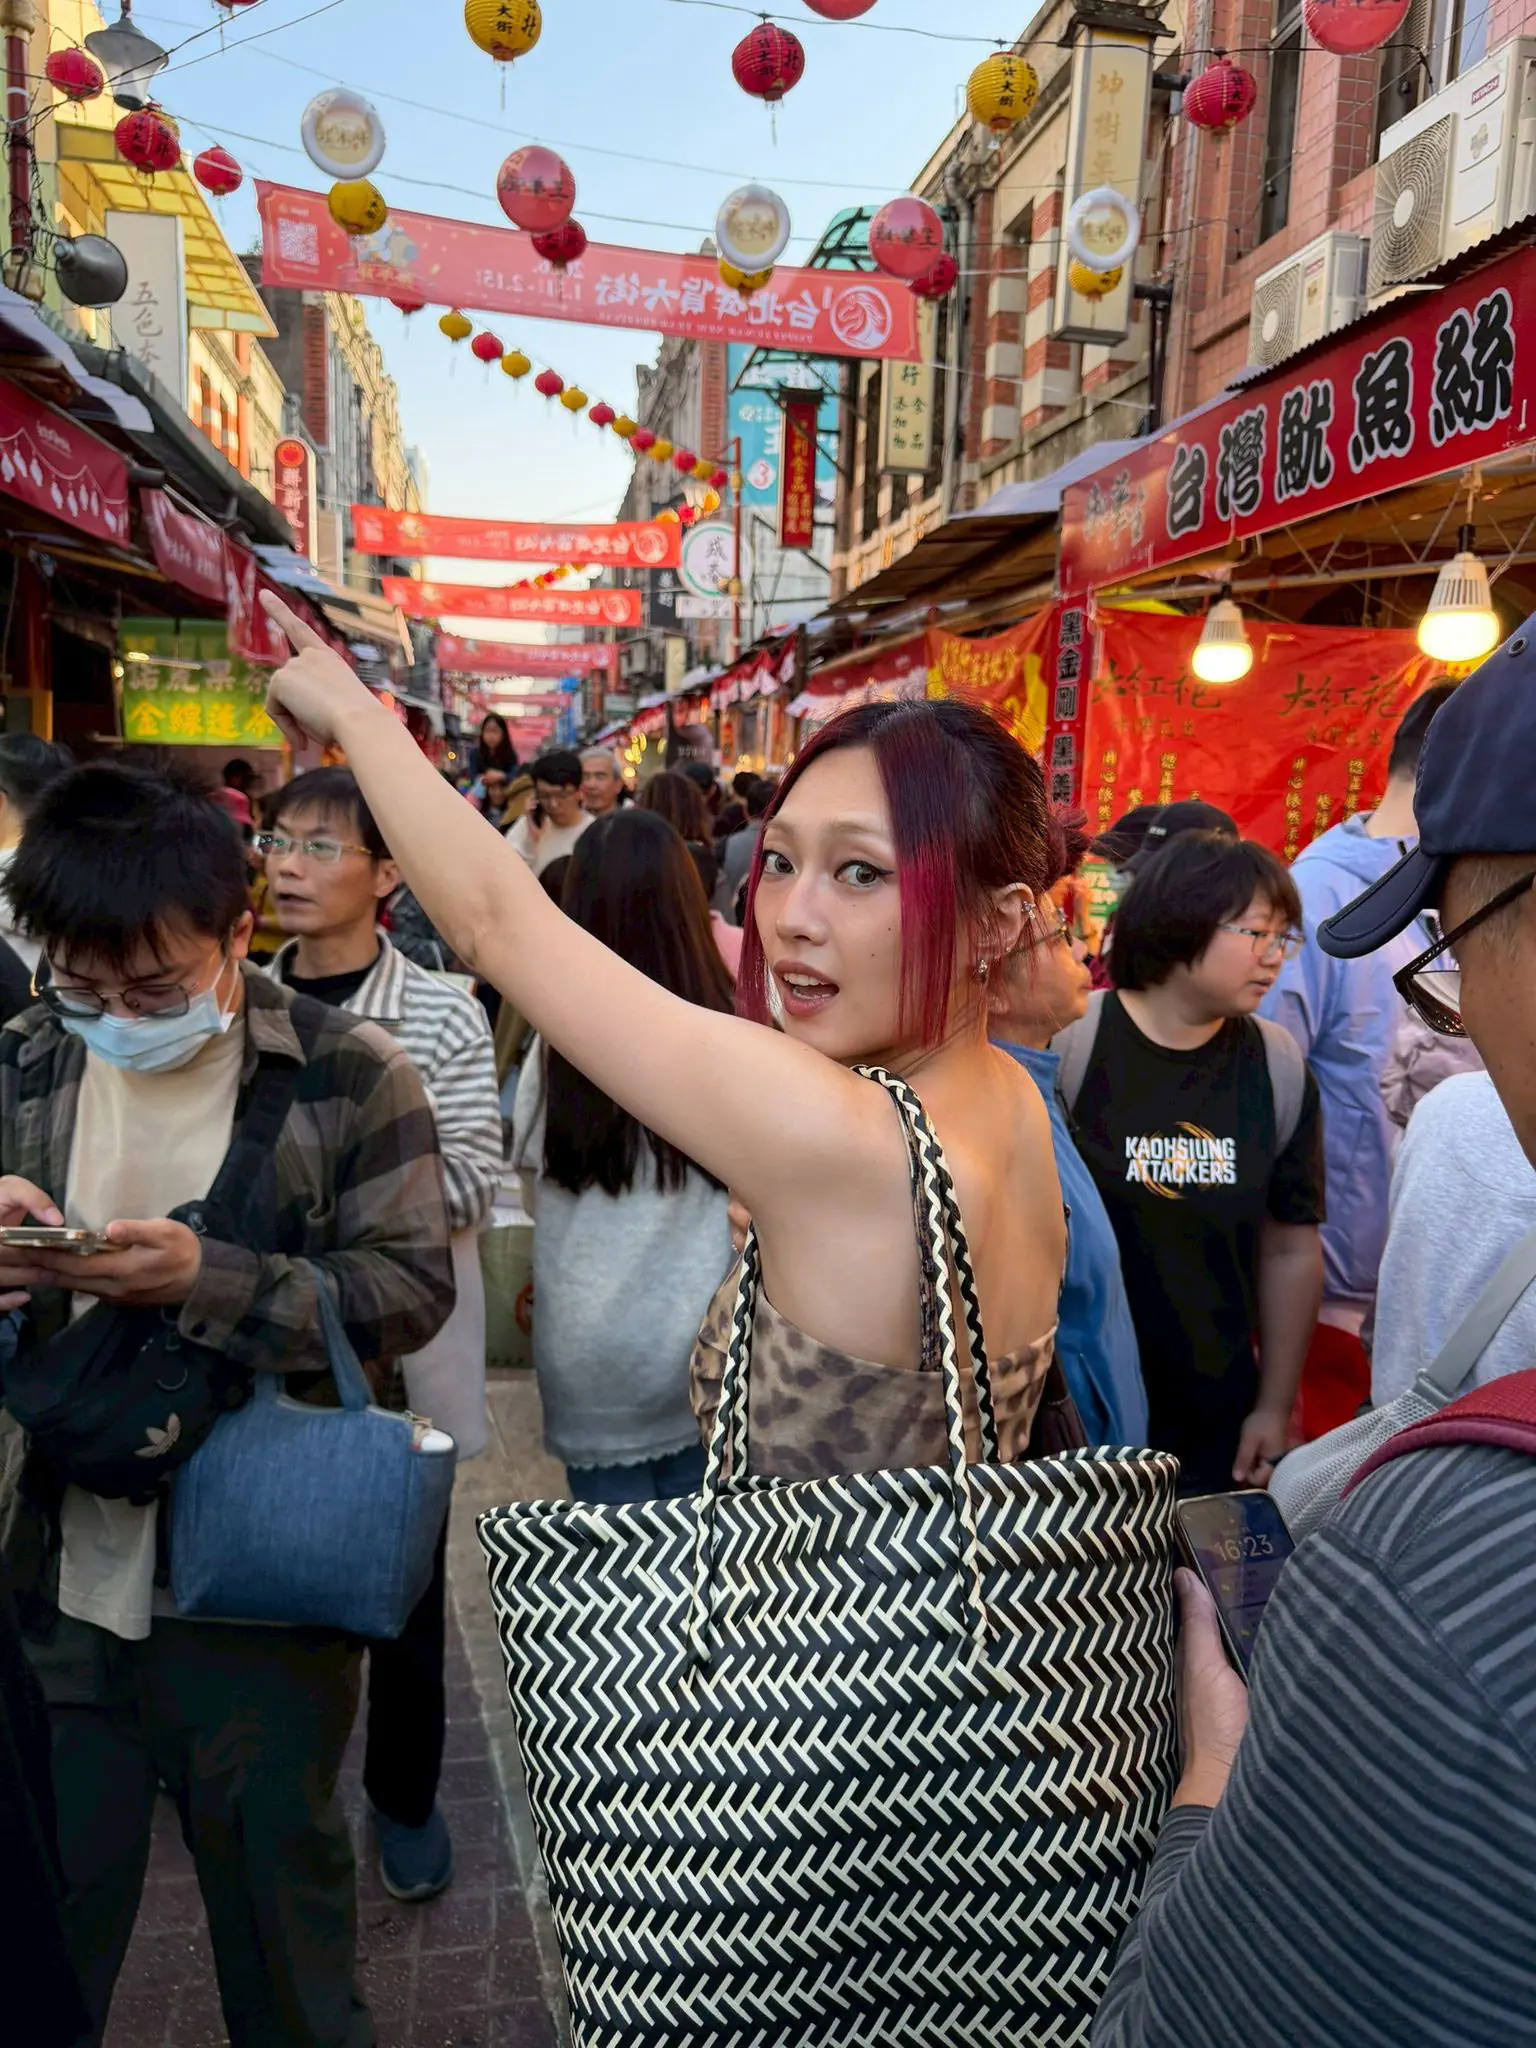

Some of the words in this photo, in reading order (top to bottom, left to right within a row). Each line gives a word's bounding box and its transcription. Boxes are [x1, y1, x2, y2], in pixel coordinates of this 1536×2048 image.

[1167, 288, 1516, 540] 台灣魷魚絲
[1125, 1136, 1236, 1161] KAOHSIUNG
[1126, 1160, 1237, 1185] ATTACKERS
[1214, 1533, 1274, 1562] 16:23
